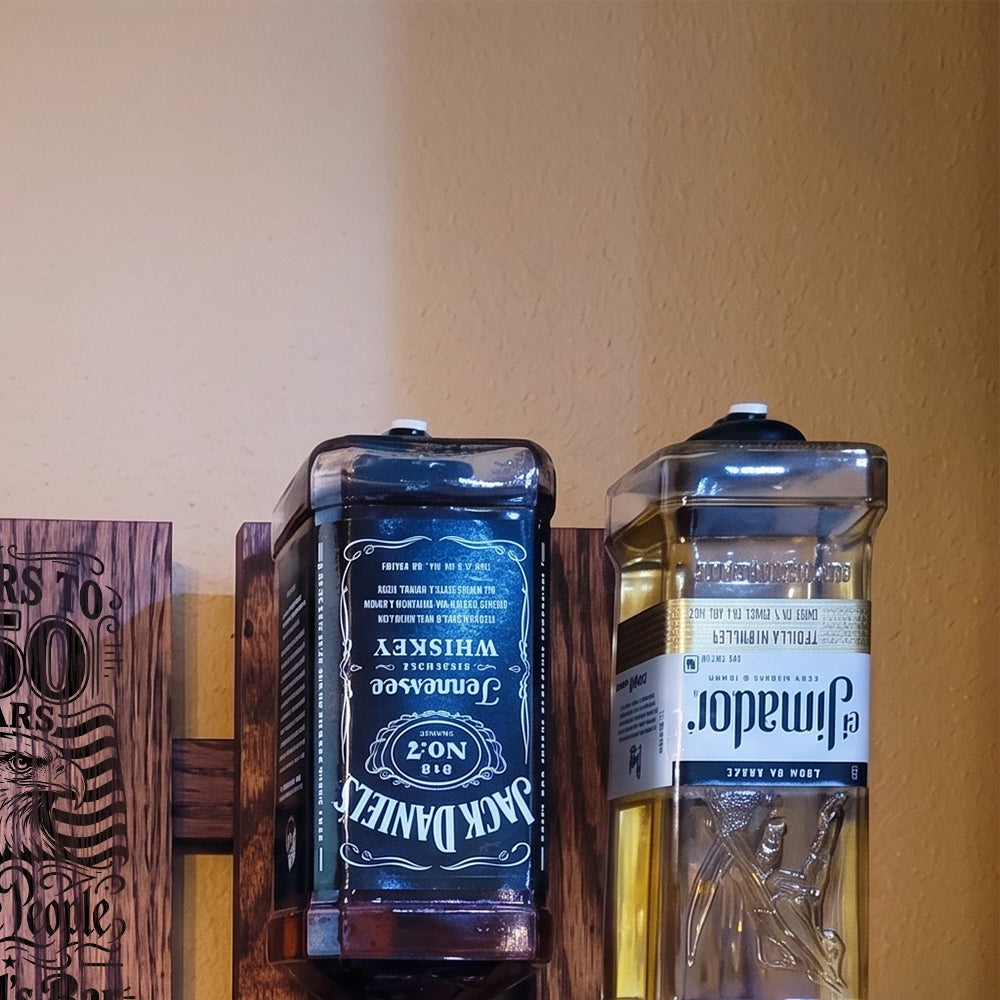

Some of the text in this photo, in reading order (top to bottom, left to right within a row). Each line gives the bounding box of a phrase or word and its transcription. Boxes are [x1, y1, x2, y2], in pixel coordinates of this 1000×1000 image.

[56, 571, 104, 620] TO
[373, 637, 498, 656] WHISKEY
[369, 677, 501, 706] Tennessee
[691, 675, 853, 751] Jimador
[455, 776, 535, 843] JACK
